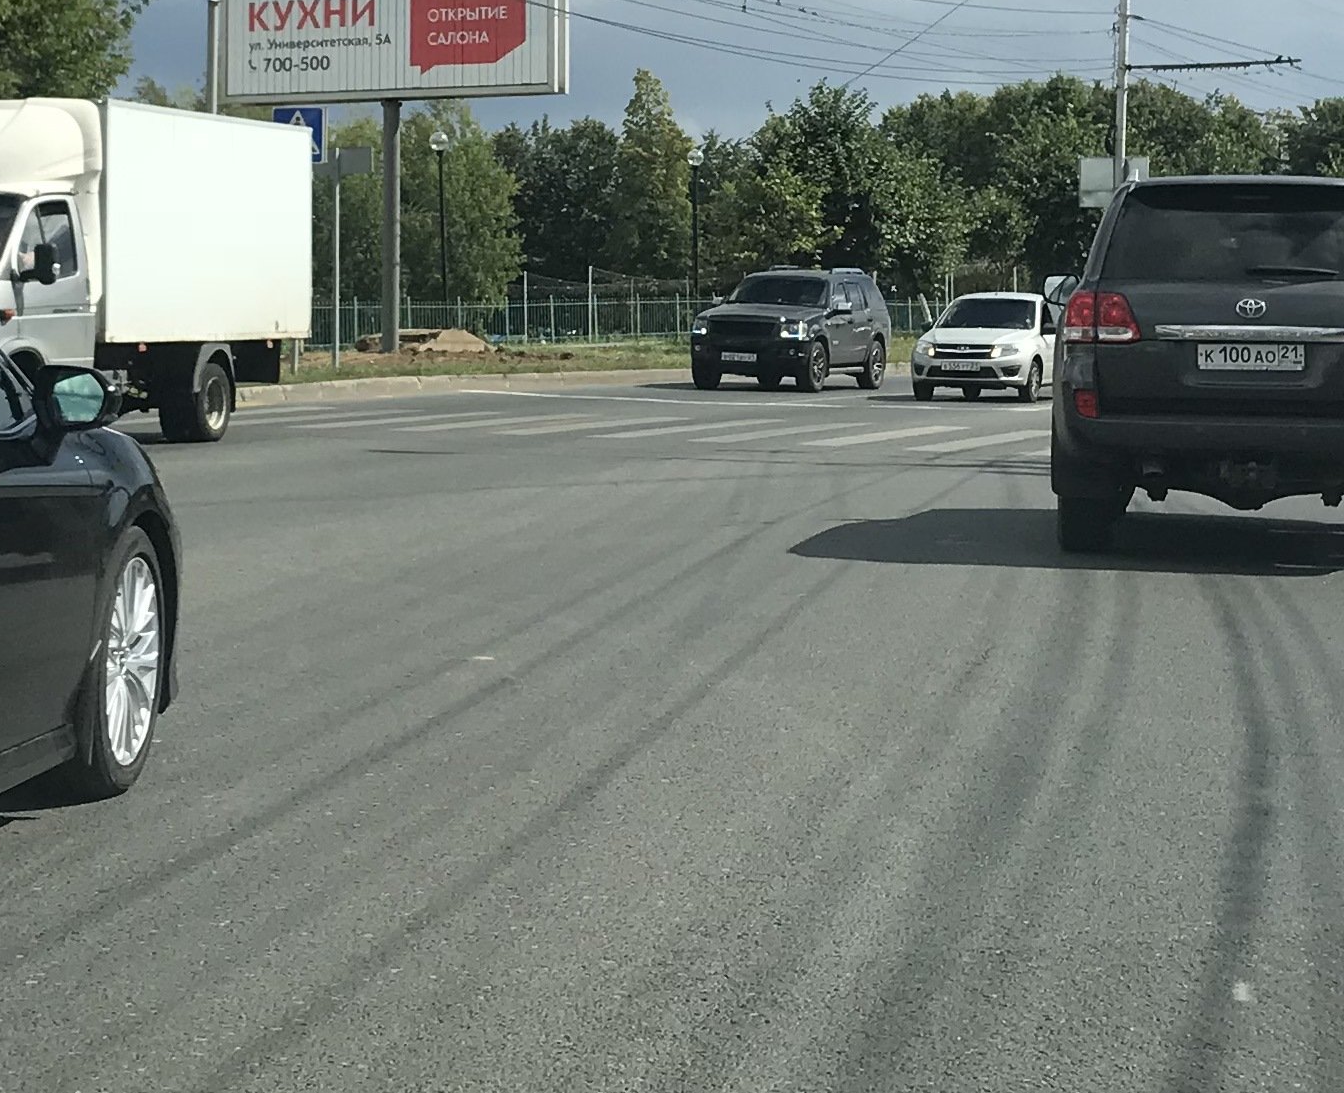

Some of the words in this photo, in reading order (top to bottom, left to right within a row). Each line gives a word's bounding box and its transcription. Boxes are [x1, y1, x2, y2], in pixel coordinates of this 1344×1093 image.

[427, 5, 508, 23] ОТКРЫТИЕ
[248, 41, 263, 54] ул.
[266, 35, 372, 52] Университетская,
[427, 30, 489, 46] САЛОНА
[263, 55, 331, 73] 700-500
